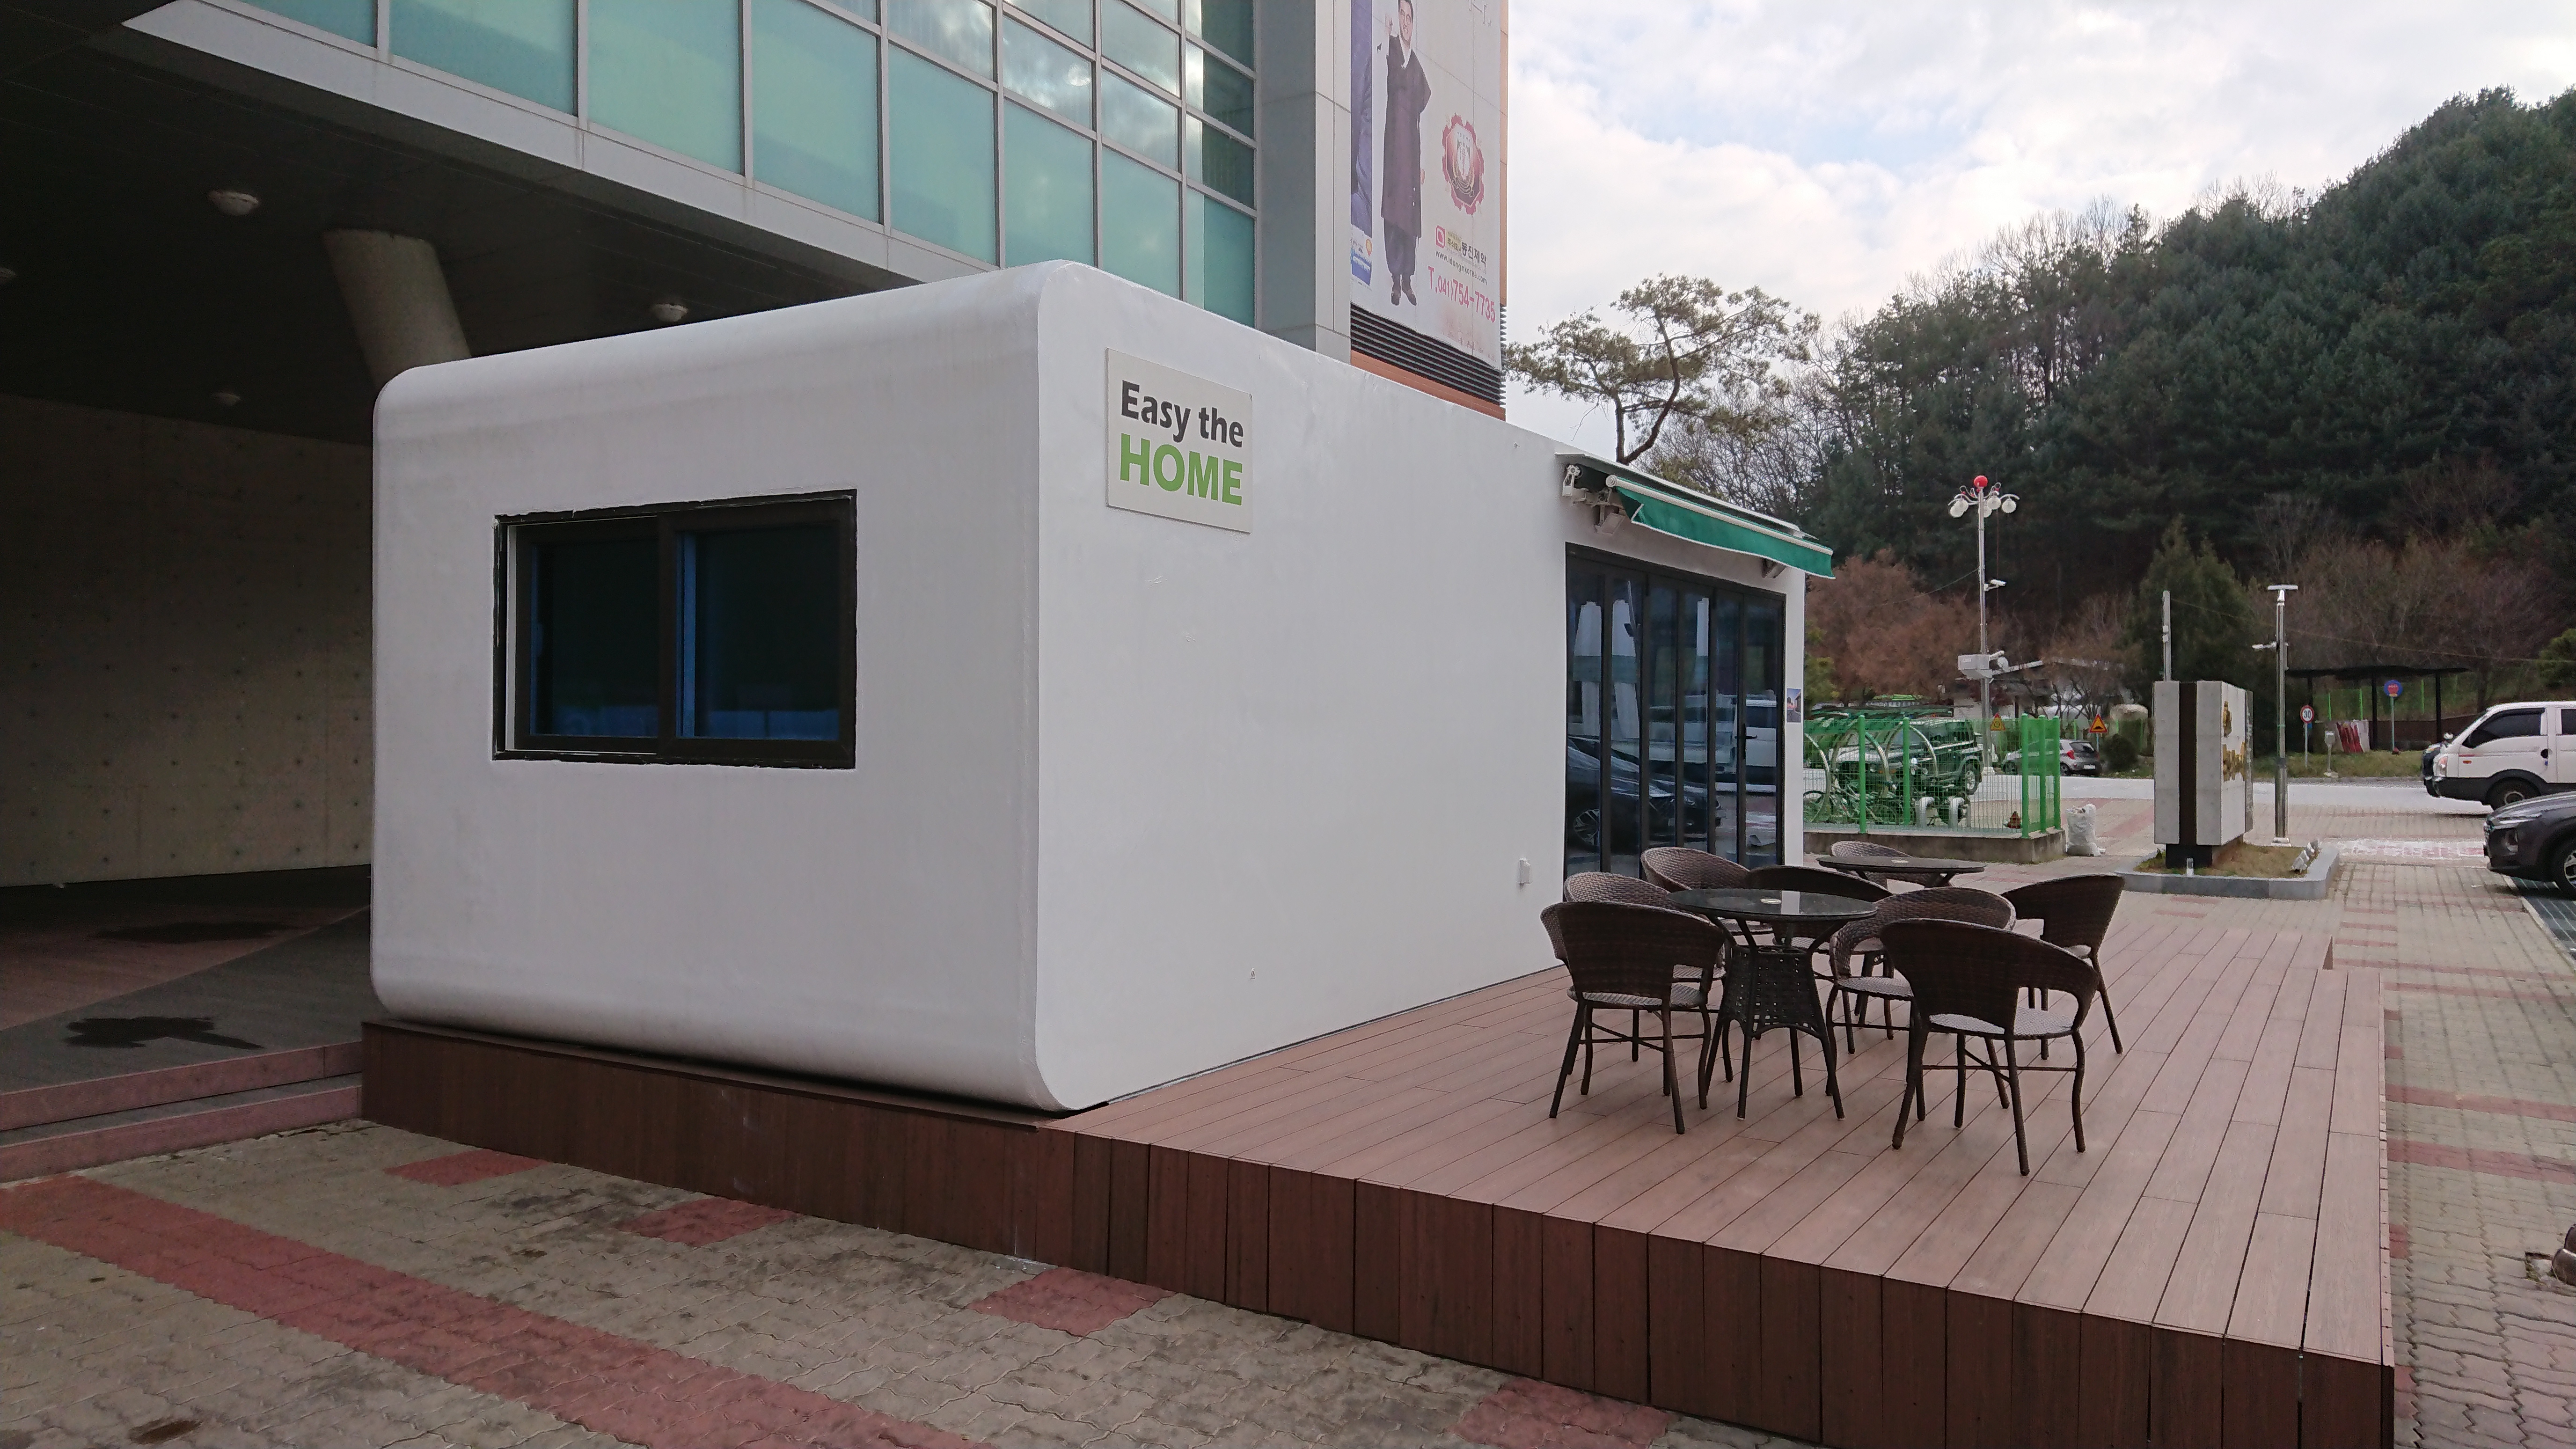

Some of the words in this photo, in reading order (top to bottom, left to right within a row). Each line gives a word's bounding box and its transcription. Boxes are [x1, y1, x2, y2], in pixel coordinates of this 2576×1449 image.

[1462, 242, 1486, 268] 동진제약
[1121, 380, 1191, 443] Easy
[1199, 407, 1244, 448] the
[1120, 433, 1243, 506] HOME
[2304, 710, 2311, 718] 30
